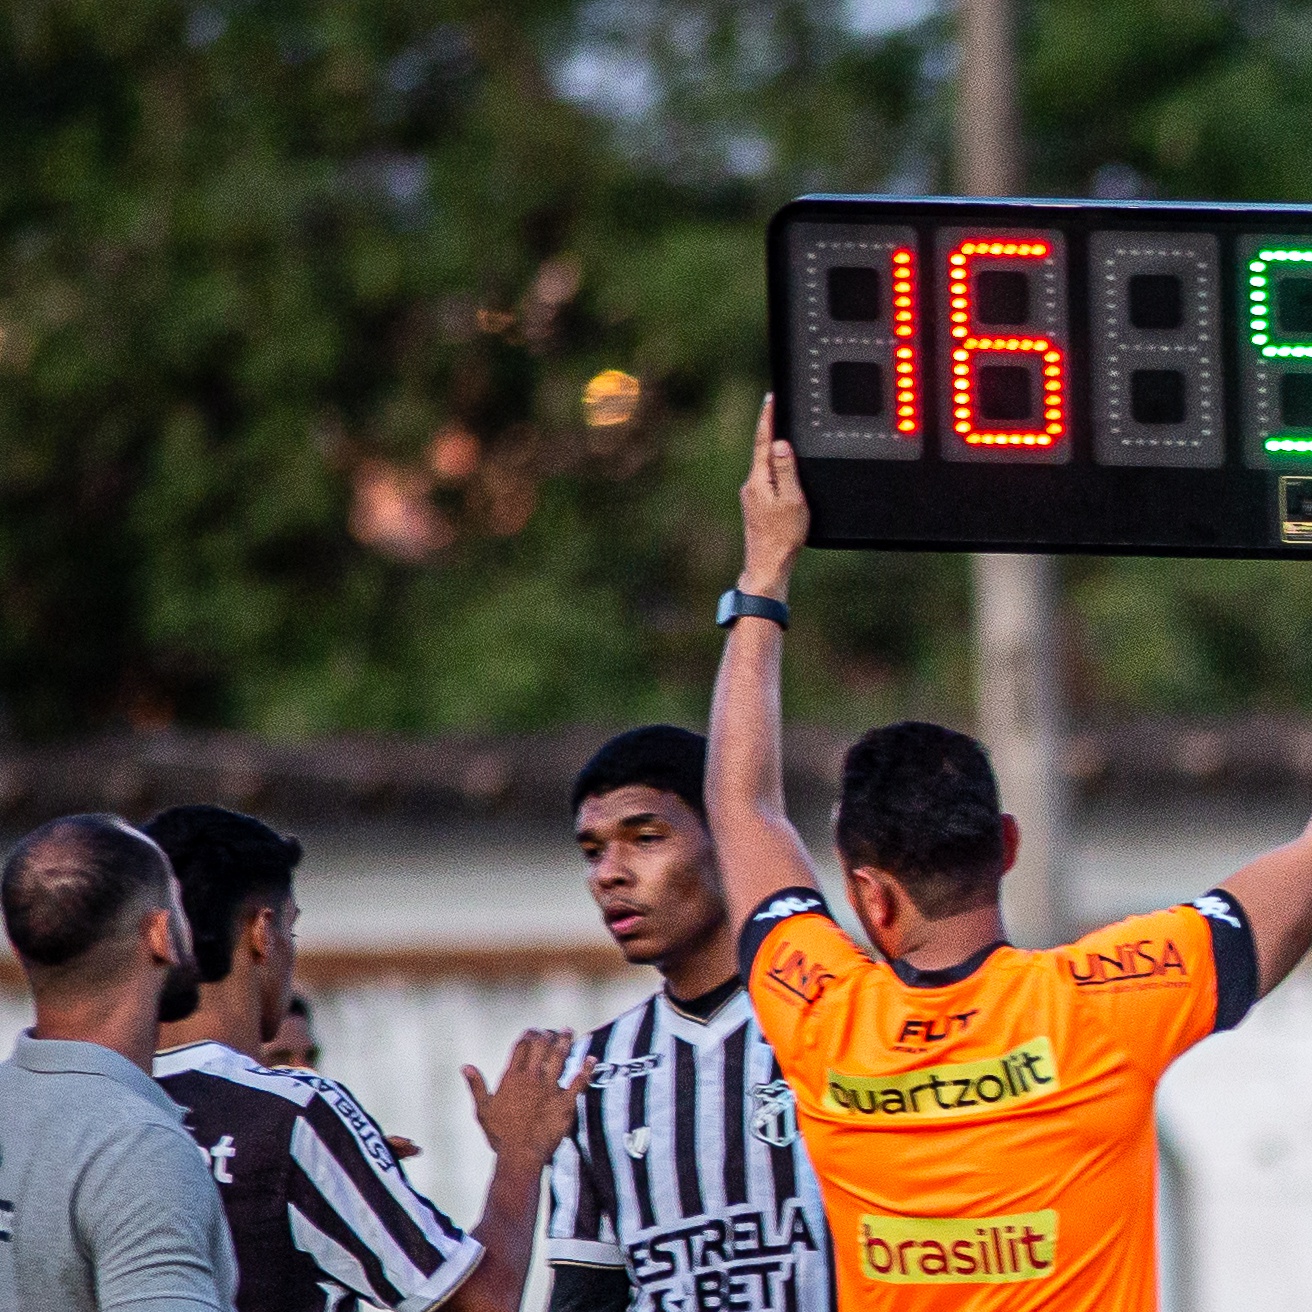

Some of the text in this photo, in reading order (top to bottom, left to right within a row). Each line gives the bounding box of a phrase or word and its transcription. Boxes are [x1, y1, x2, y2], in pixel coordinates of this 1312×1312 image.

[891, 239, 1065, 448] 16
[1068, 939, 1187, 982] UNISA
[898, 1010, 979, 1043] FUT
[629, 1206, 820, 1285] ESTRELA
[864, 1223, 1051, 1275] brasilit
